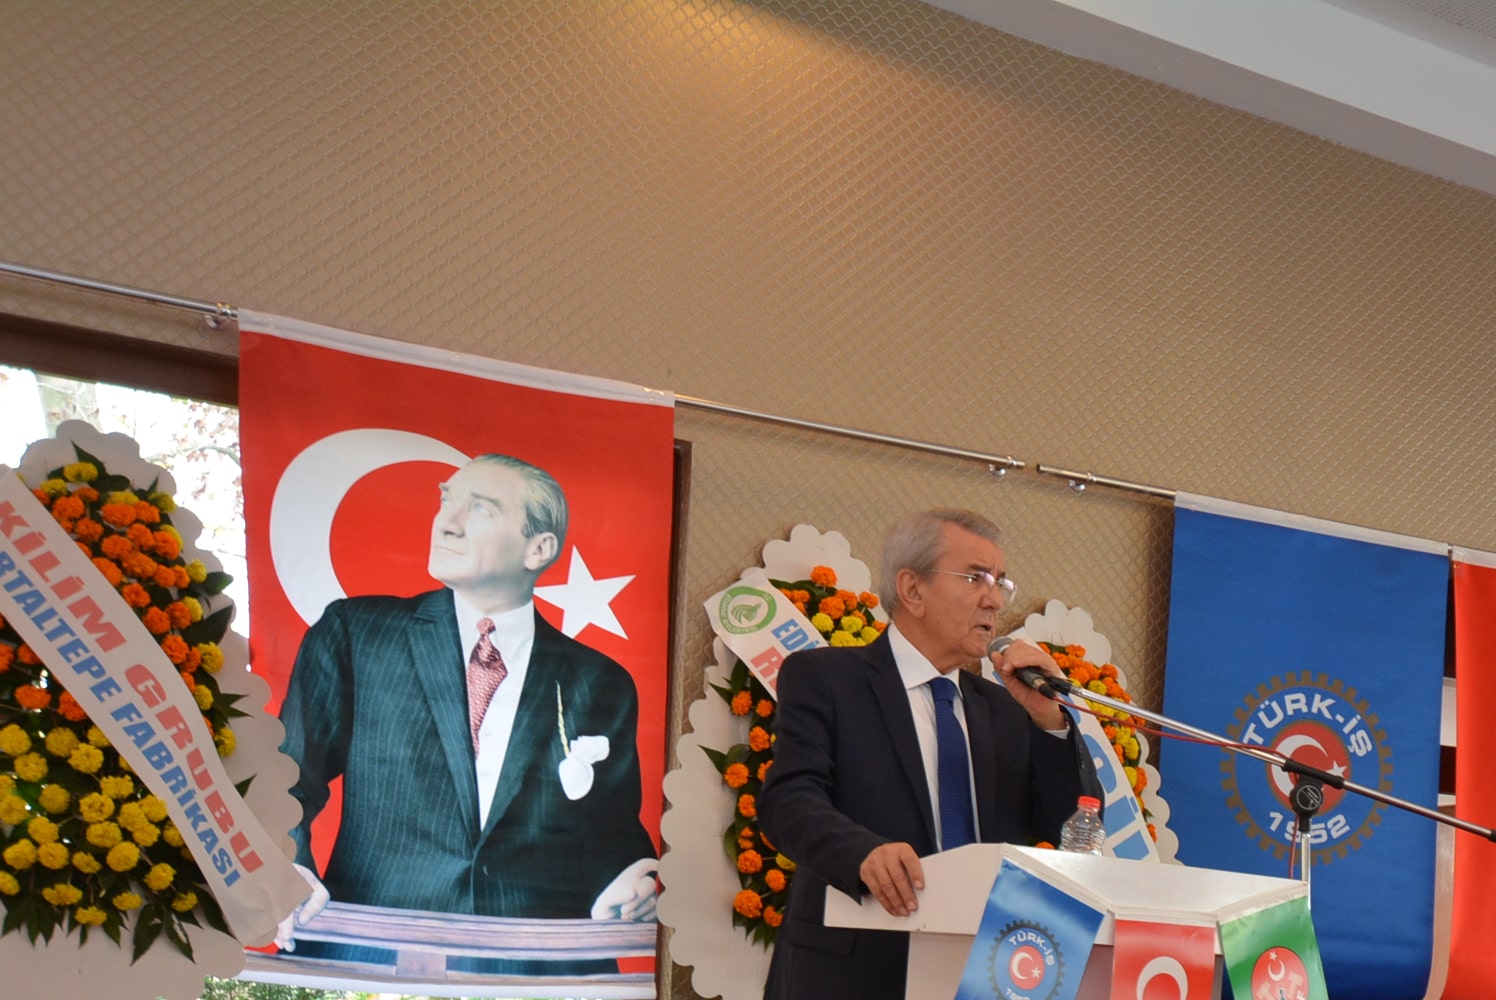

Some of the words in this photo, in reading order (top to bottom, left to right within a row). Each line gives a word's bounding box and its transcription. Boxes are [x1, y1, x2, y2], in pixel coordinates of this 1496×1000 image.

[0, 500, 127, 654] KİLİM
[125, 663, 264, 874] GRUBU
[1242, 693, 1373, 757] TÜRK-İŞ
[110, 705, 243, 888] FABRİKASI
[1269, 812, 1351, 844] 1952
